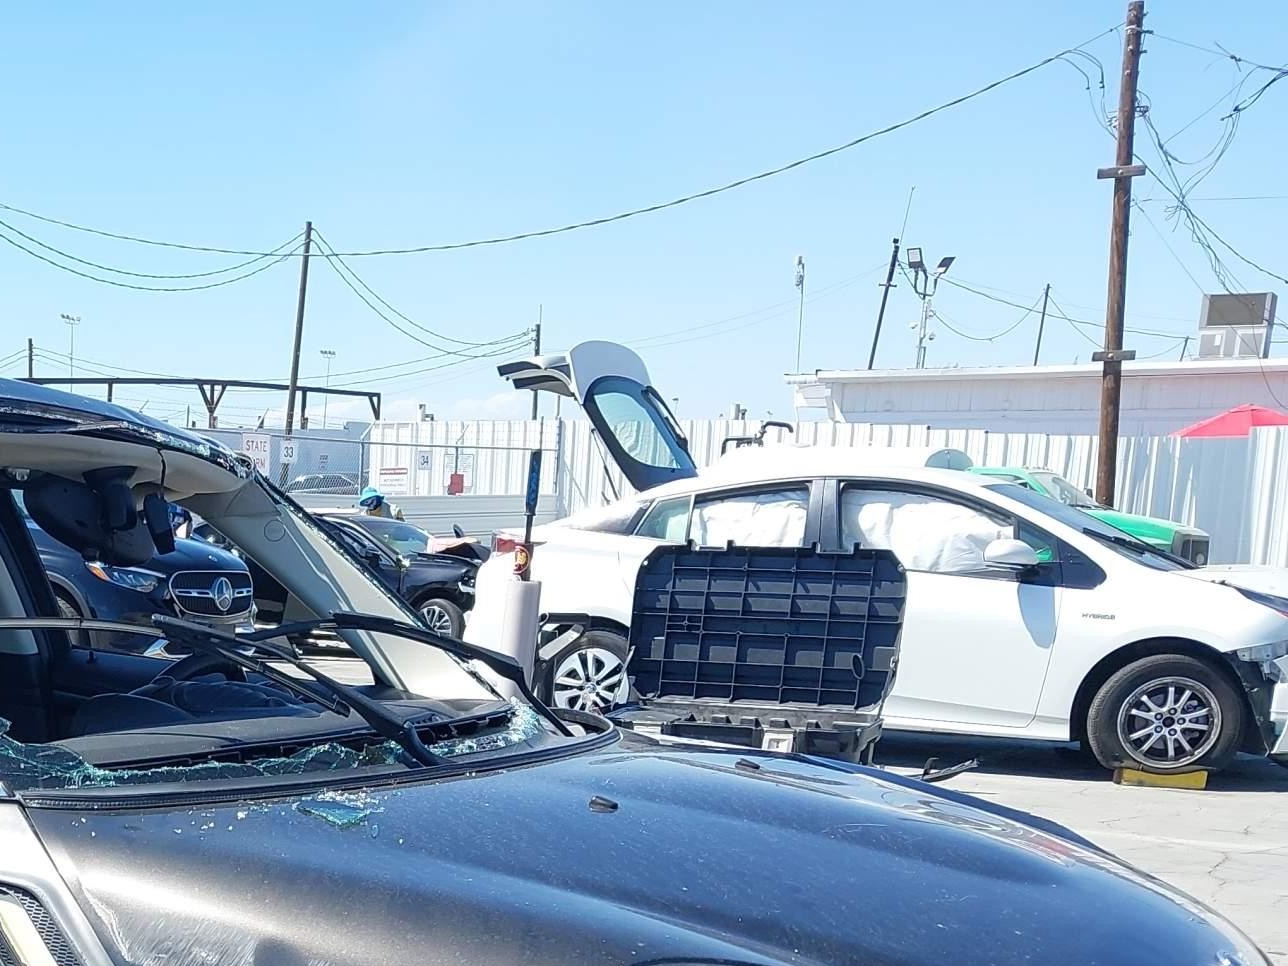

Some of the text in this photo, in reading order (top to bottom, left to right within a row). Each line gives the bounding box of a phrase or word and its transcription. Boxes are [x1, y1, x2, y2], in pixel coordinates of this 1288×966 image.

[245, 440, 268, 453] STATE
[283, 446, 294, 458] 33
[420, 455, 429, 466] 34
